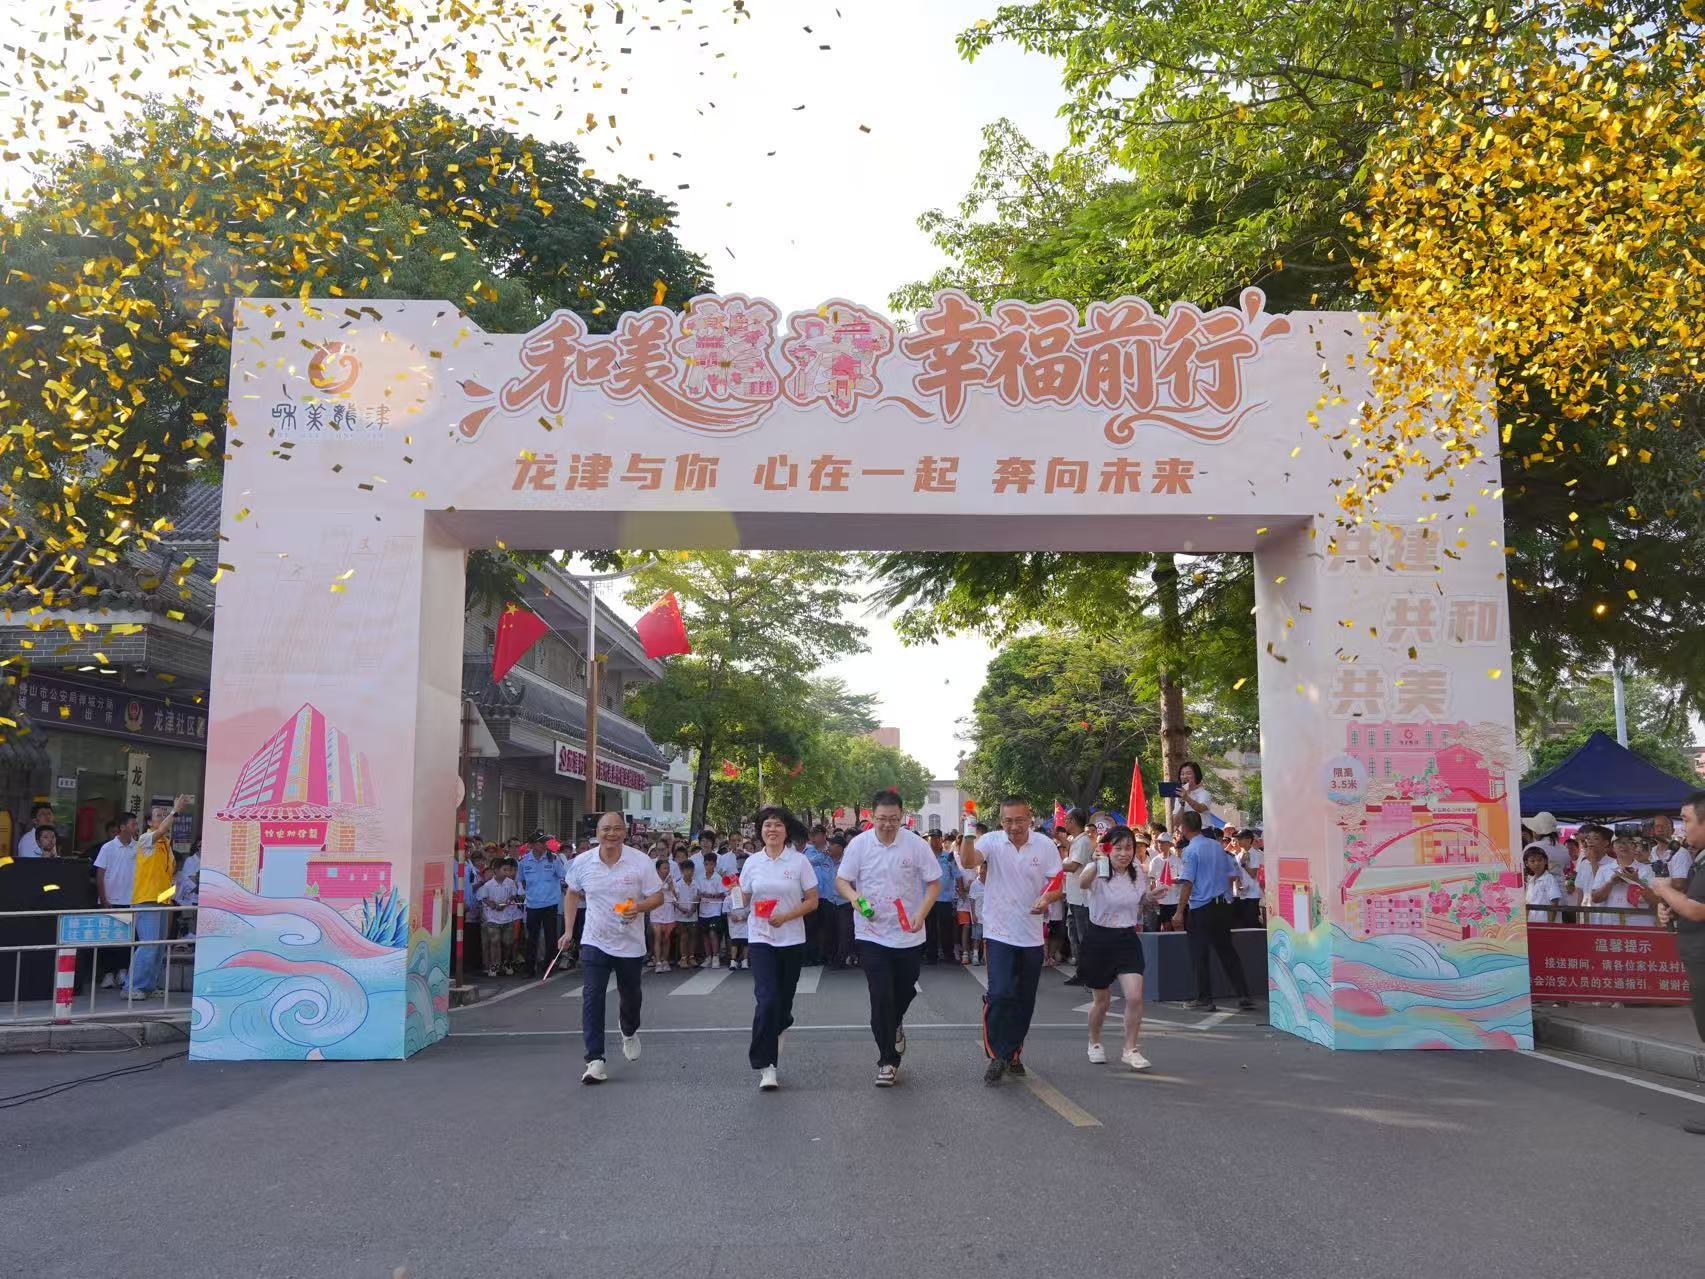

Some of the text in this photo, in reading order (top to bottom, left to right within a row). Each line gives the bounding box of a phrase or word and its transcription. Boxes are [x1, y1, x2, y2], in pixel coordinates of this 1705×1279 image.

[904, 297, 1257, 424] 幸福前行
[511, 453, 1199, 494] 龙津与你 心在一起 奔向未来
[1325, 525, 1442, 572] 共建
[1386, 598, 1499, 643] 共和
[18, 696, 113, 724] 城南出所
[1334, 669, 1449, 715] 共美
[1331, 777, 1358, 790] 3.5米
[1333, 767, 1354, 778] 限高
[1595, 938, 1652, 954] 温馨提示
